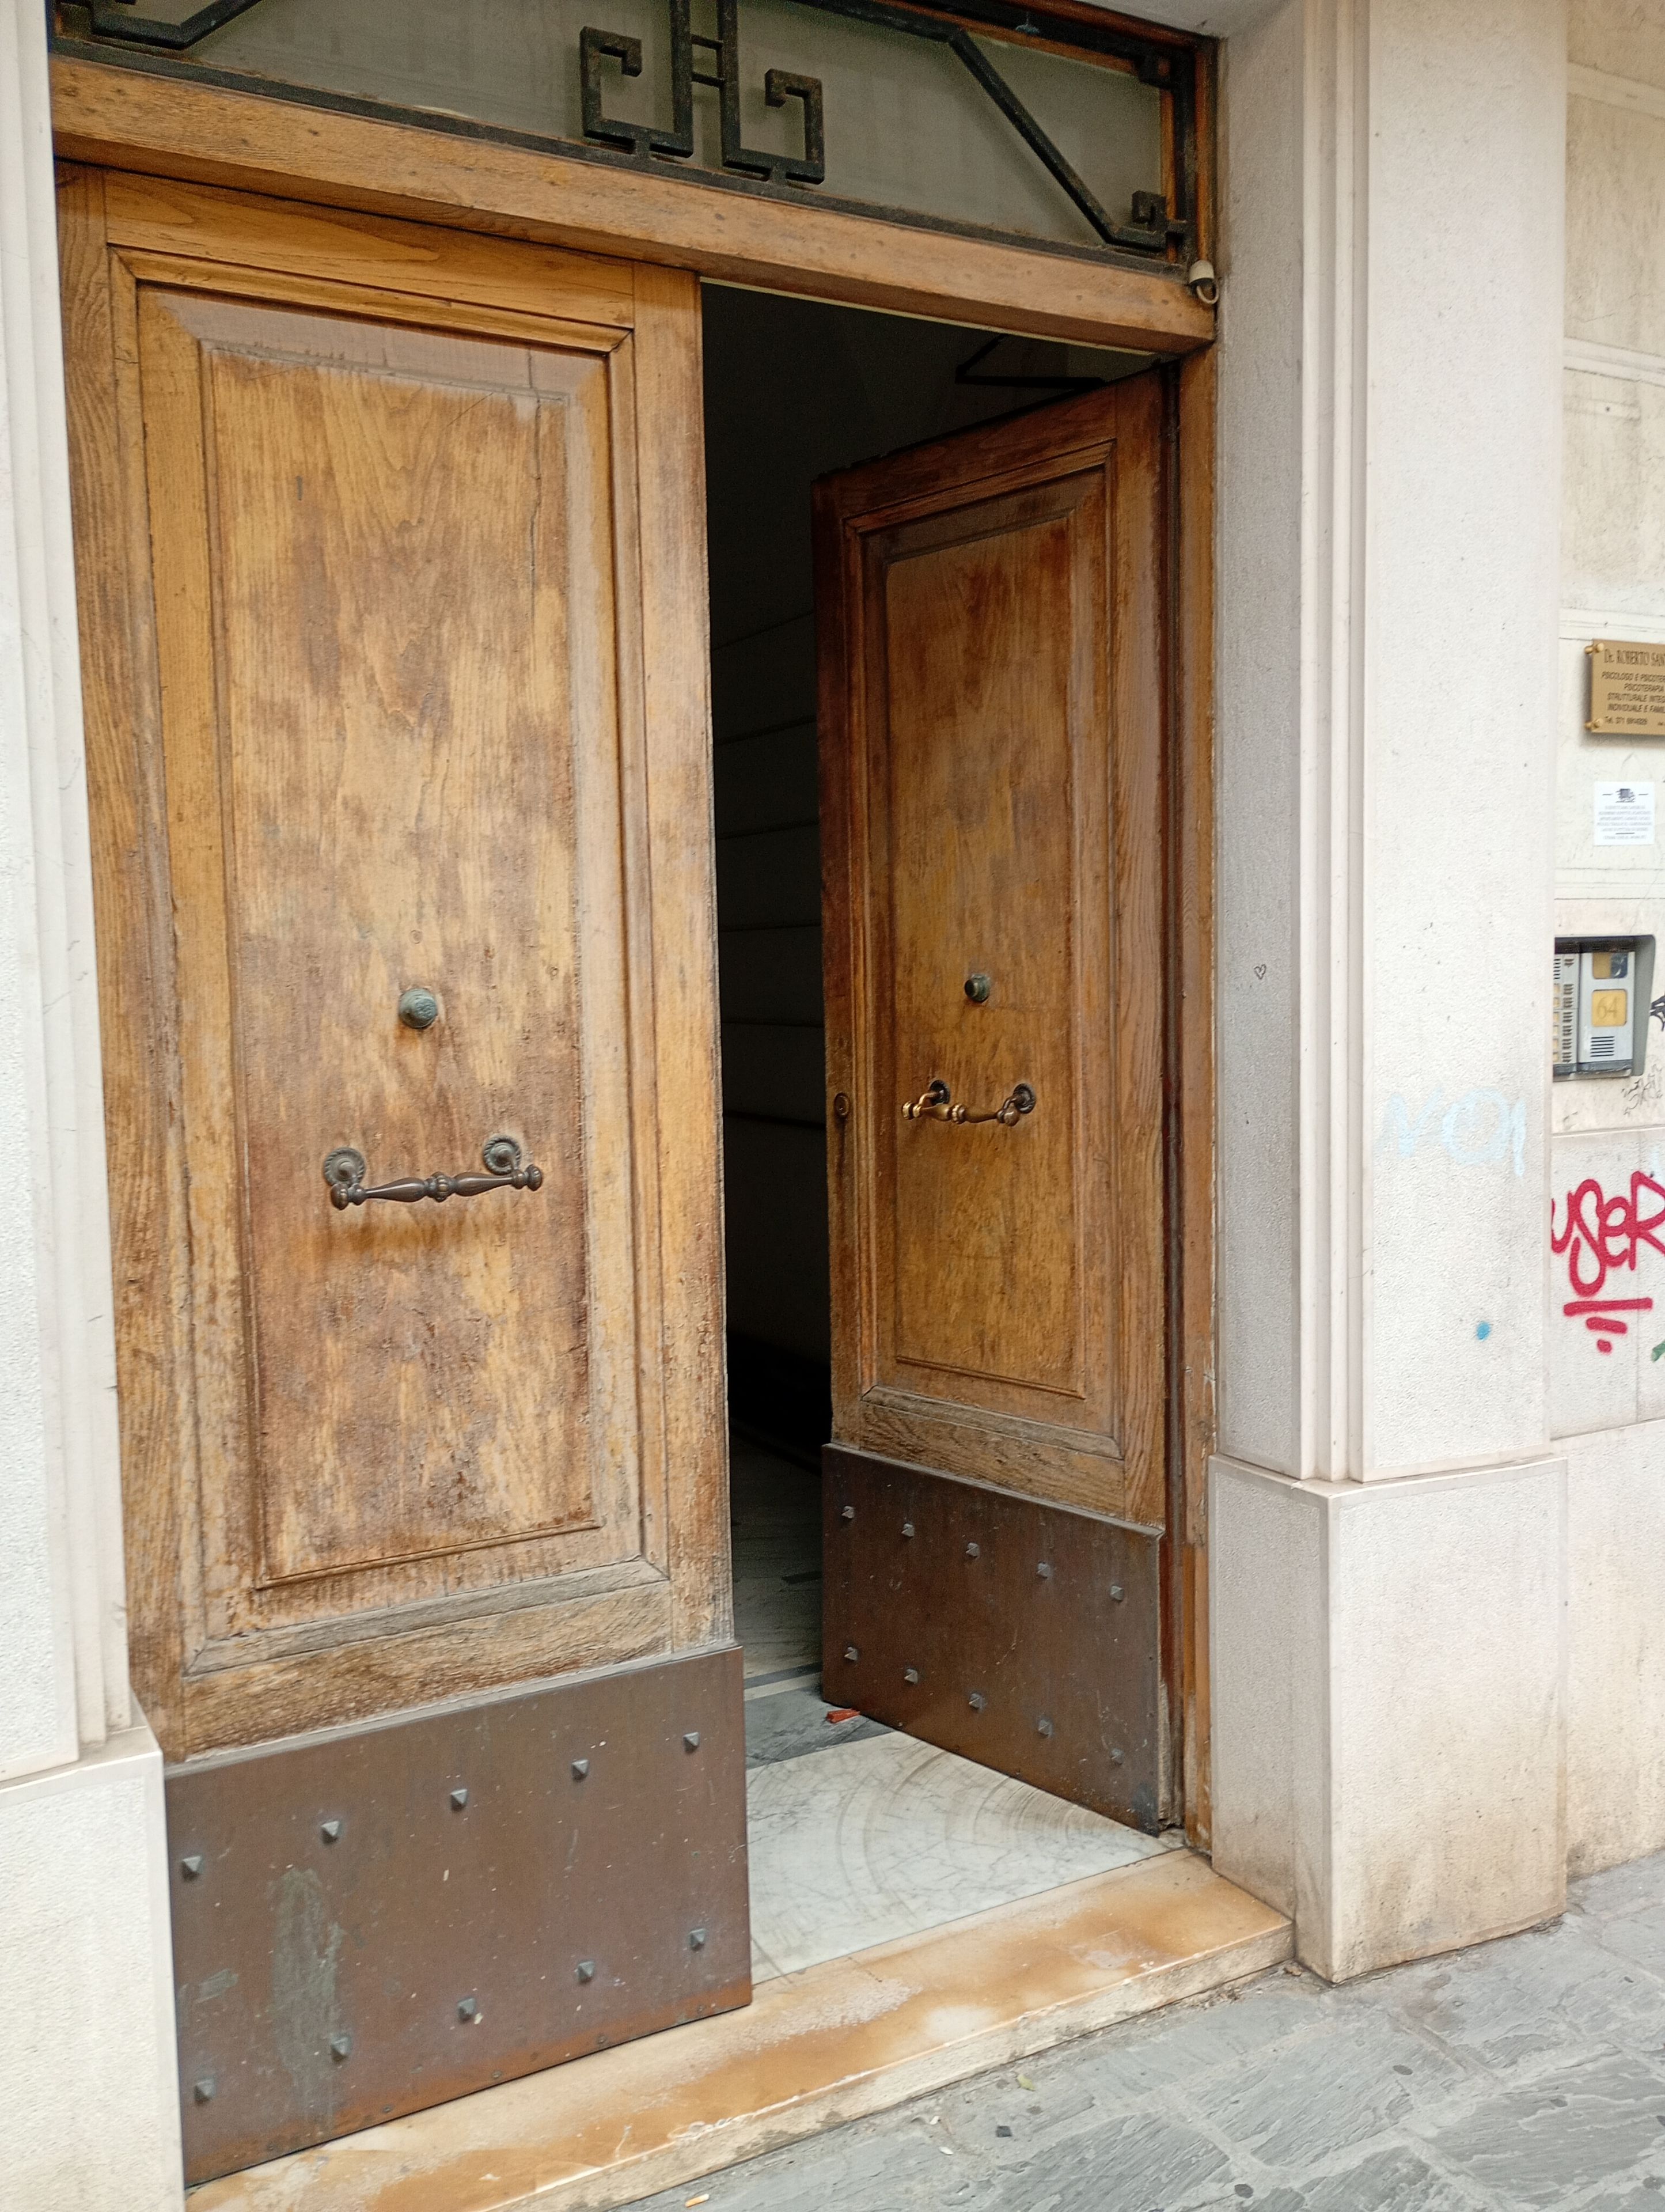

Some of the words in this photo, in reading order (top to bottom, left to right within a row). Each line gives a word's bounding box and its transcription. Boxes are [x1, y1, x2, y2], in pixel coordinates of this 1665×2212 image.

[1616, 649, 1649, 665] ROBERTO
[1650, 652, 1665, 666] SAN
[1601, 671, 1634, 680] PSICOLOGO
[1634, 673, 1639, 681] E
[1624, 683, 1664, 692] PSICOTERAPIA
[1607, 692, 1648, 702] STRUTTURALE
[1607, 703, 1643, 713] INDIVIDUALE
[1643, 704, 1648, 713] E
[1597, 995, 1619, 1020] 64
